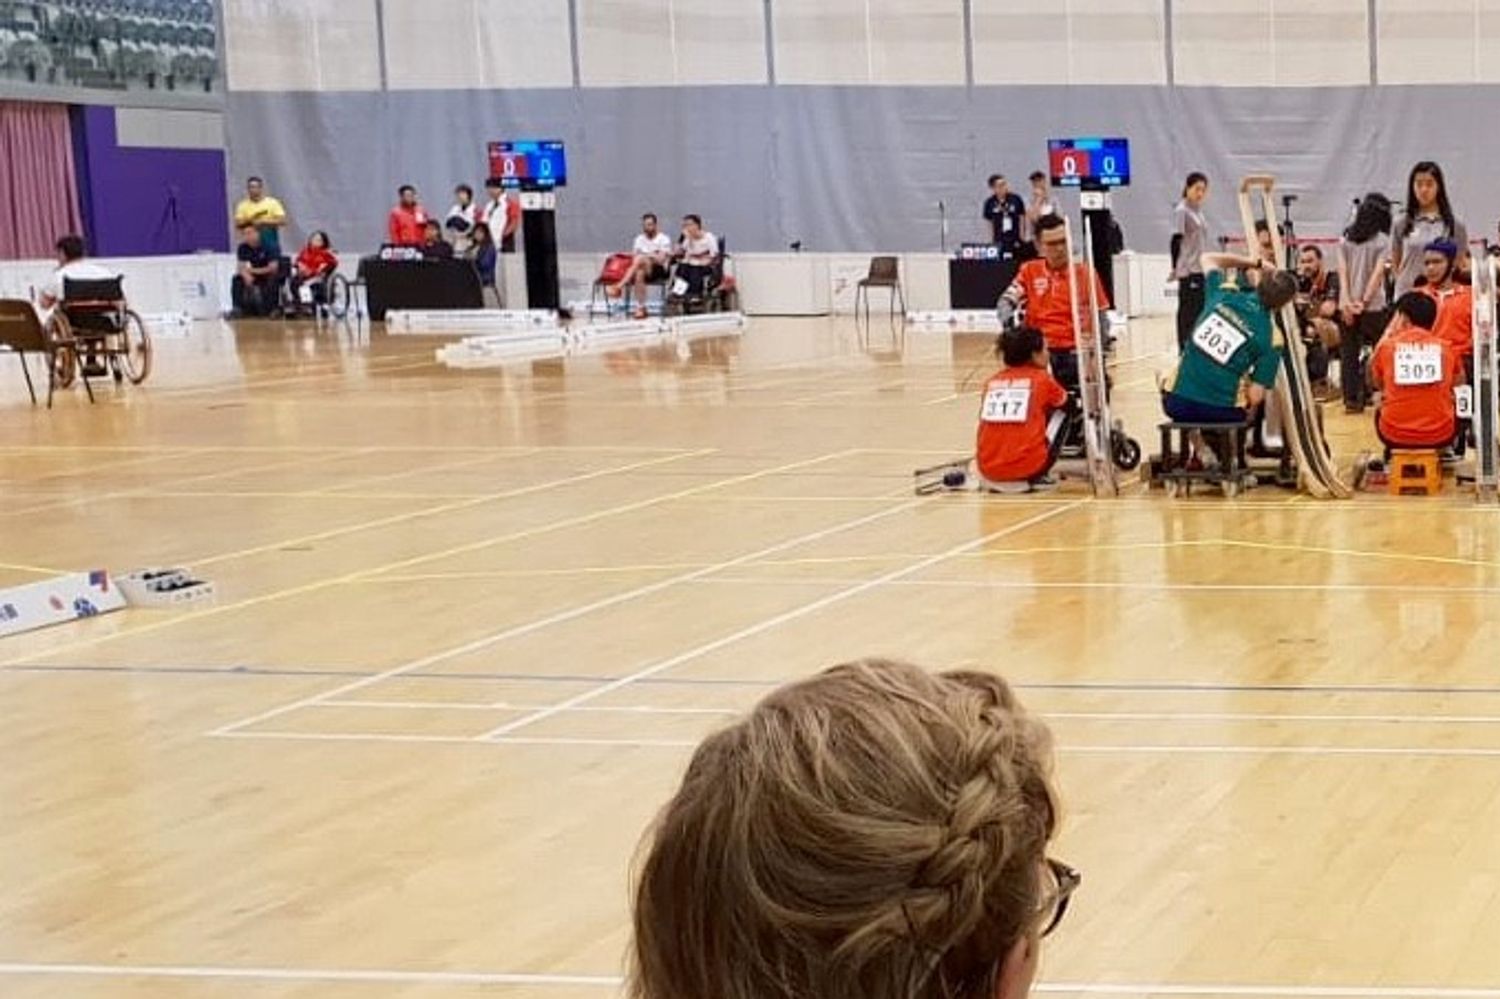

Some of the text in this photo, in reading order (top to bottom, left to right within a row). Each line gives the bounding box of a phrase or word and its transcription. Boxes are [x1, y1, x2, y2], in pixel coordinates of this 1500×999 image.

[1062, 155, 1115, 176] 0 0
[1198, 326, 1232, 356] 303
[1398, 363, 1437, 380] 309
[986, 401, 1023, 417] 317
